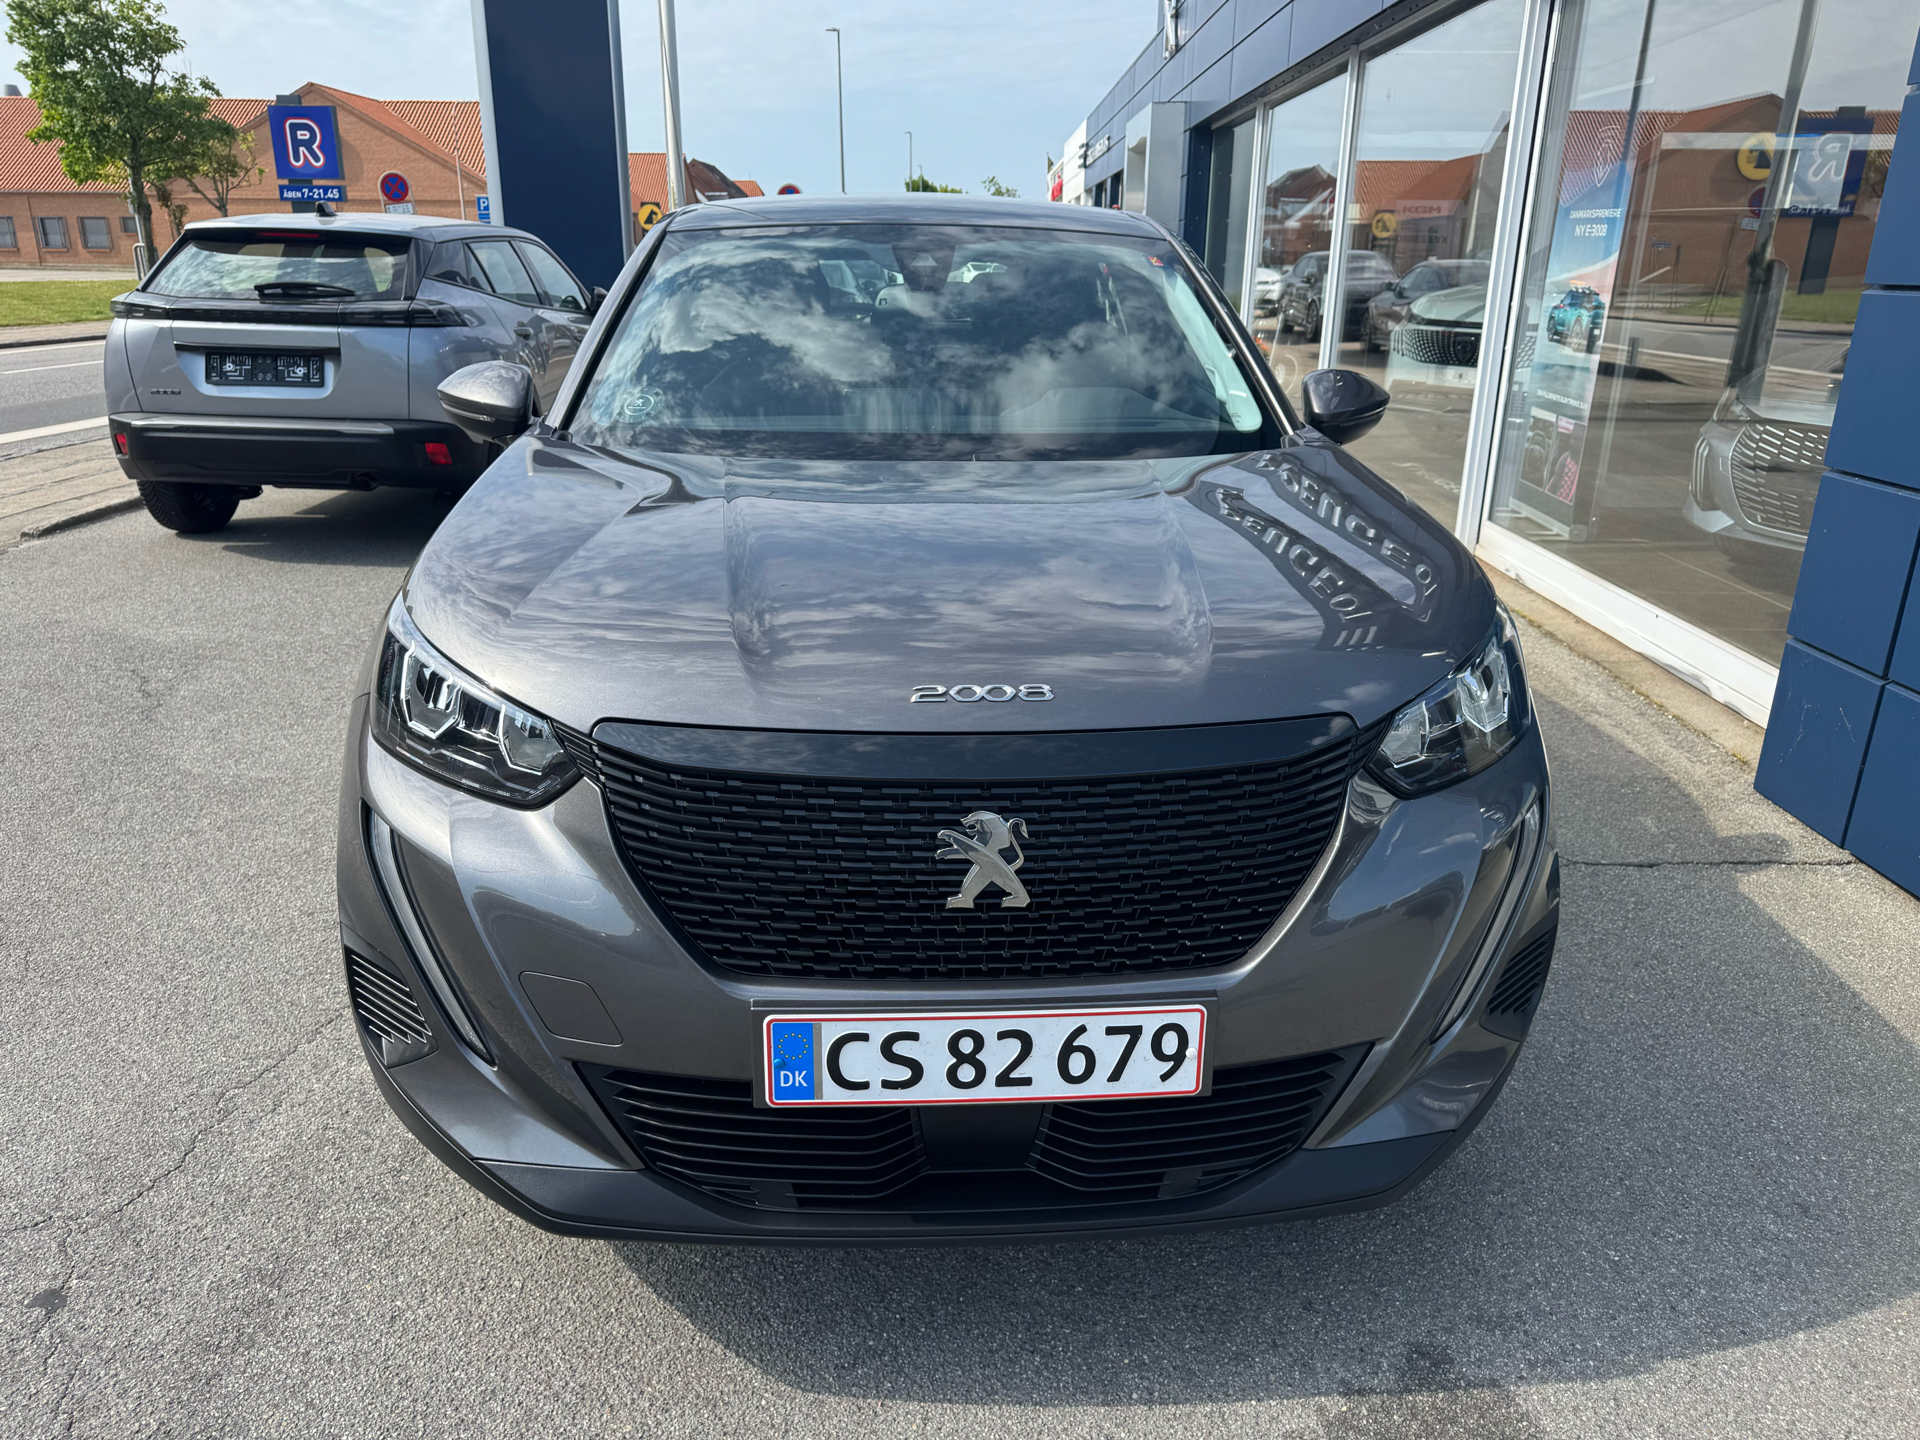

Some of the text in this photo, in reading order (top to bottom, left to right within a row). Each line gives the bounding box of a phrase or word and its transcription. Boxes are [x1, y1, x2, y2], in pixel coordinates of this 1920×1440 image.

[284, 117, 326, 169] R
[283, 188, 340, 199] ÅBEN 7-21.45
[480, 198, 488, 210] P
[1570, 208, 1622, 219] DANMARKSPREMIERE
[1575, 224, 1608, 236] NY E-3008
[911, 683, 1055, 703] 2008
[780, 1022, 1190, 1091] DK CS 82 679
